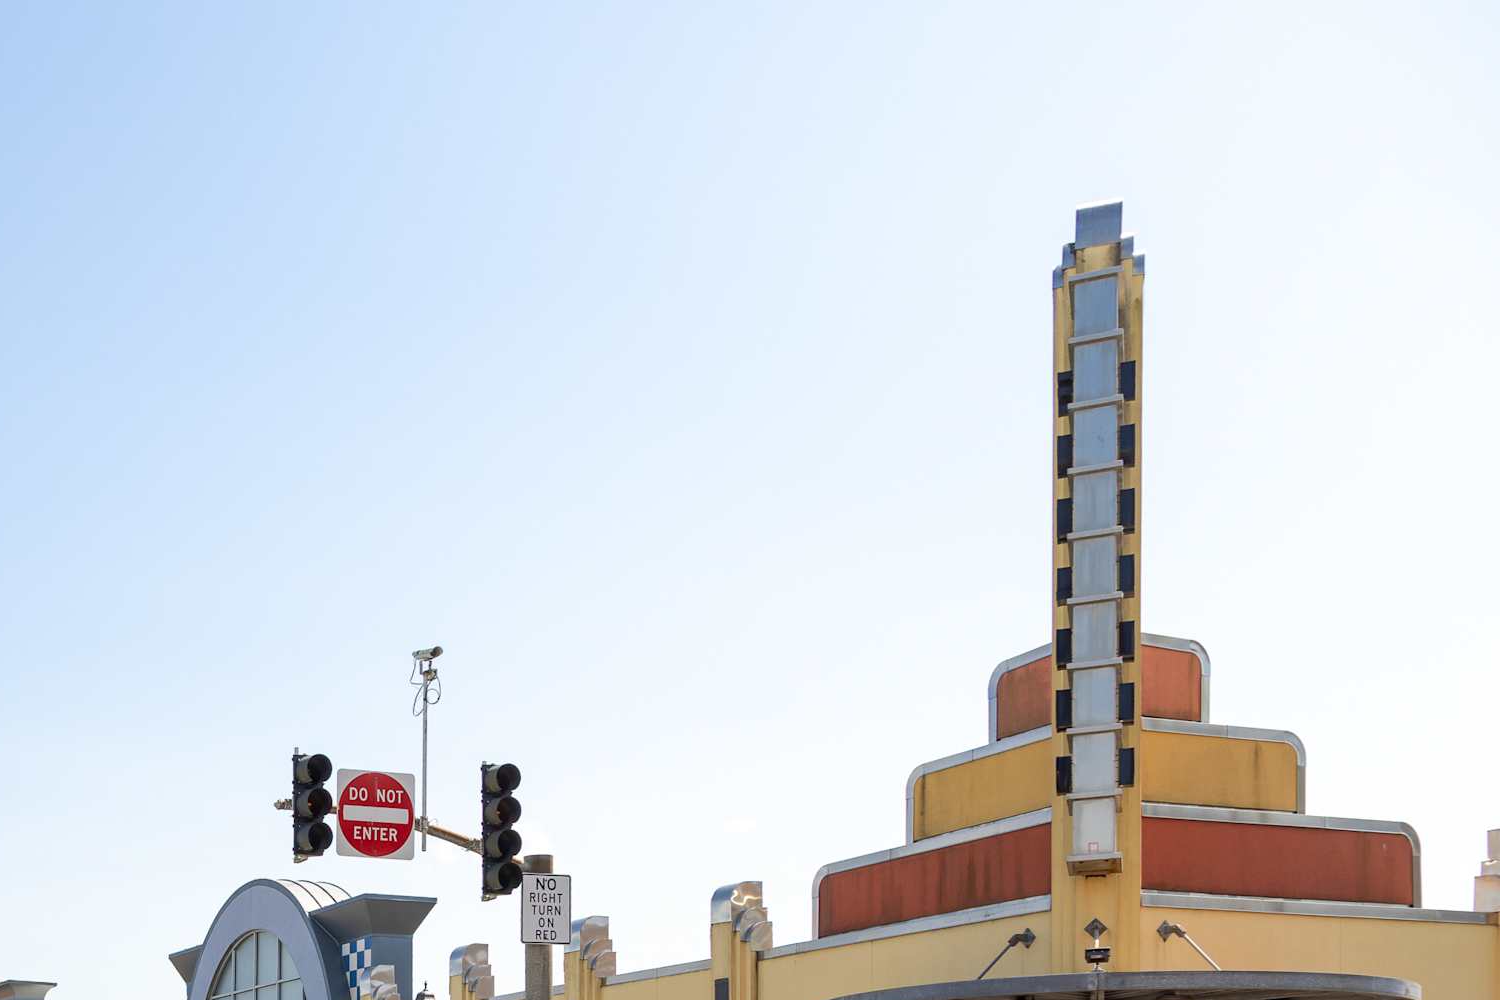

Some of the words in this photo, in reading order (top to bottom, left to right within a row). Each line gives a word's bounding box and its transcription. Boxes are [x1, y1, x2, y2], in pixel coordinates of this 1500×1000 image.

[349, 787, 368, 802] DO
[376, 789, 404, 804] NOT
[353, 825, 398, 842] ENTER
[536, 878, 557, 891] NO
[529, 893, 563, 903] RIGHT
[532, 905, 561, 915] TURN
[539, 917, 554, 928] ON
[536, 930, 557, 940] RED
